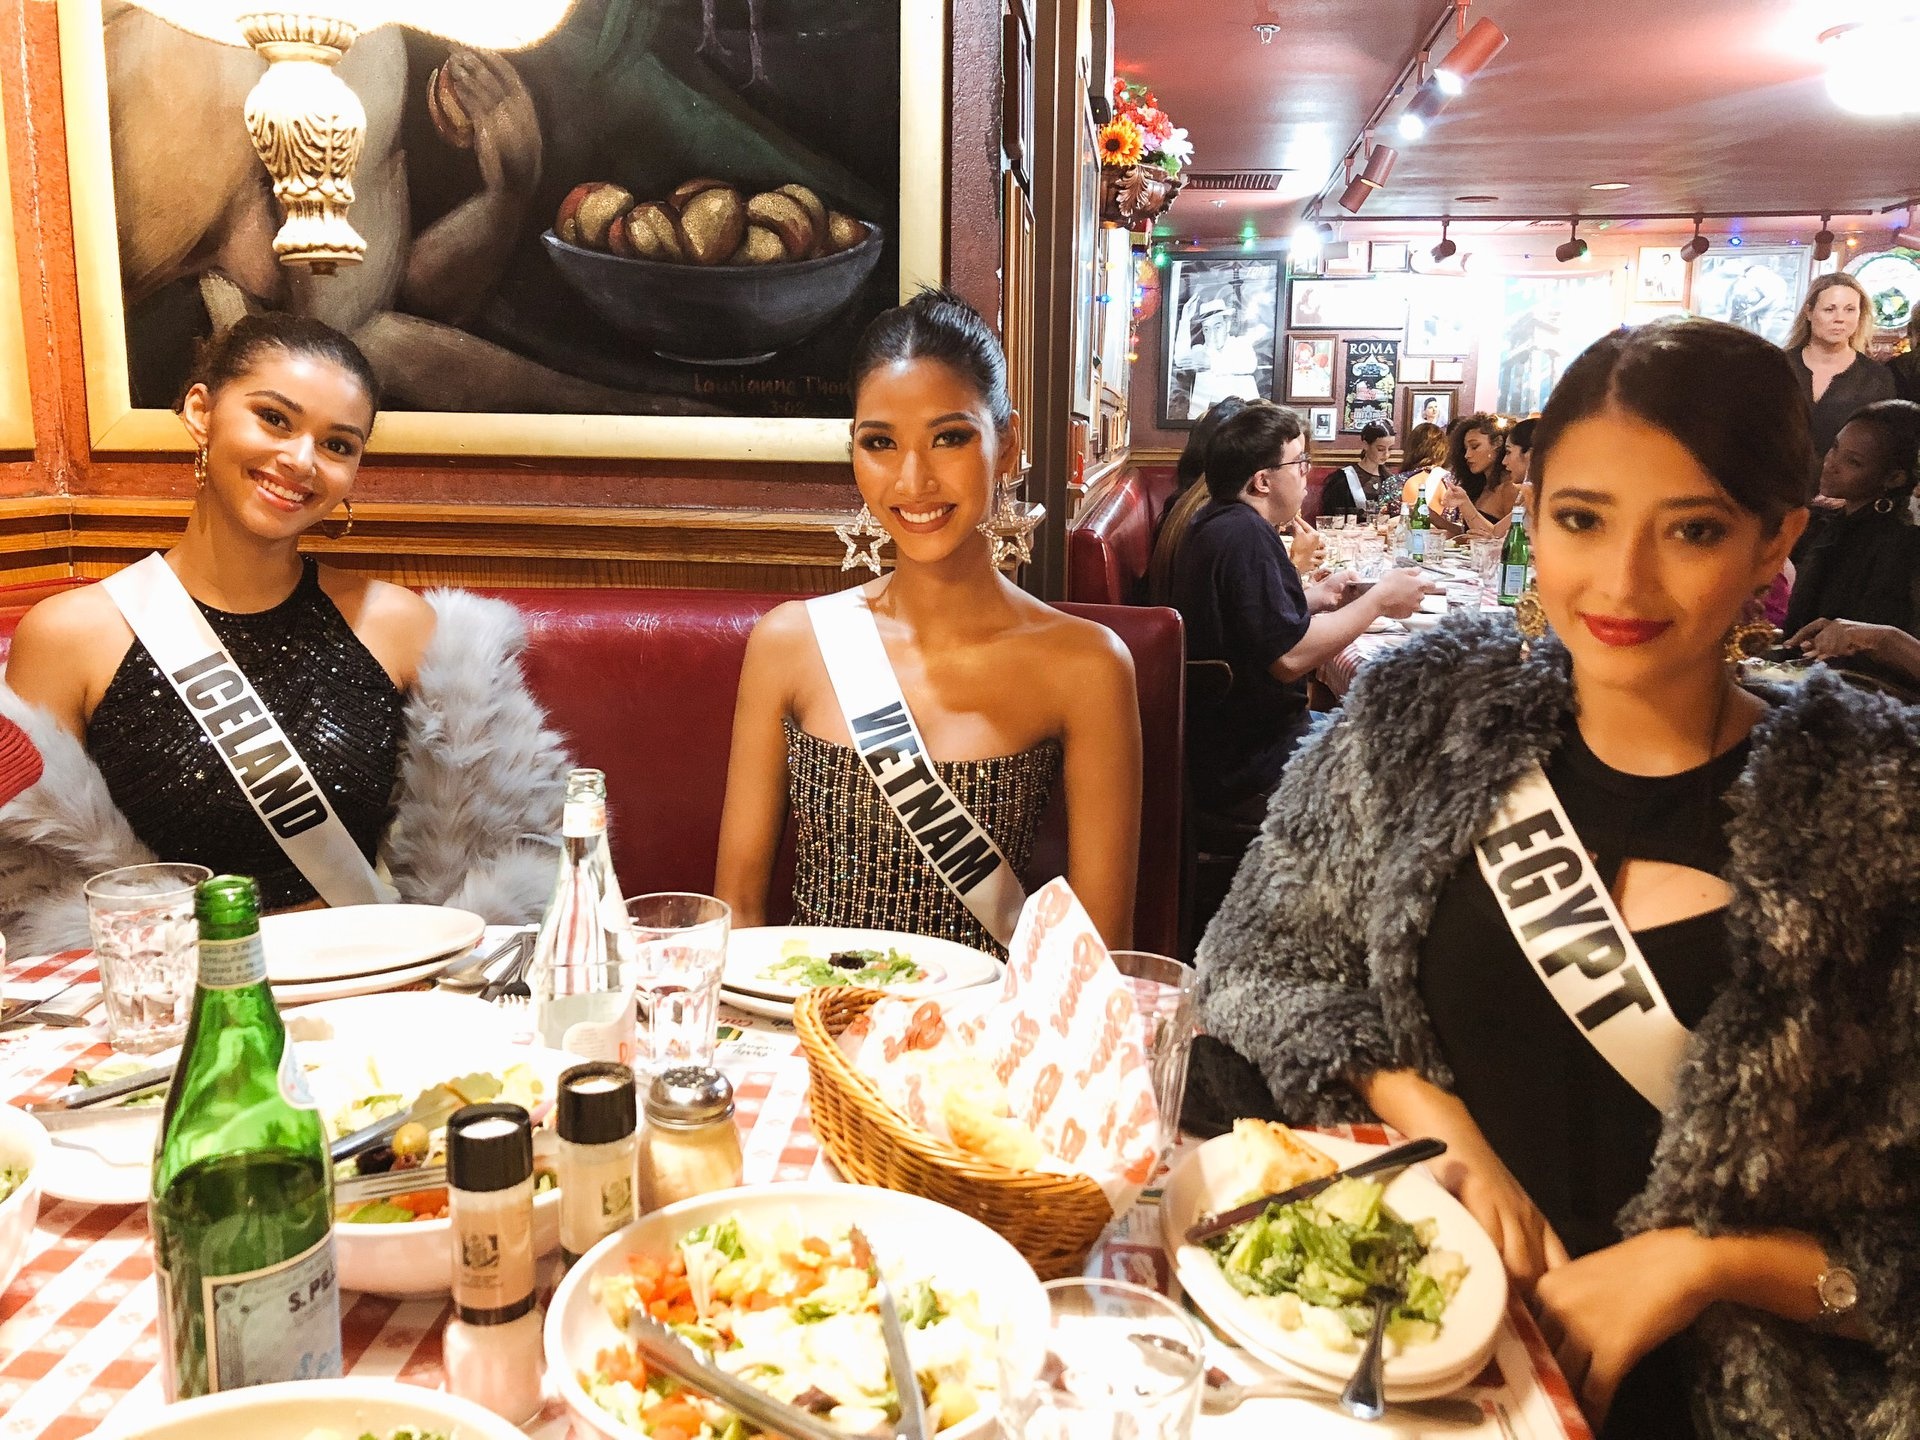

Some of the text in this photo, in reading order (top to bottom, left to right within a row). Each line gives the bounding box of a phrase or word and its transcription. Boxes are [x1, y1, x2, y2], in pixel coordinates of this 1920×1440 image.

[1349, 343, 1395, 355] ROMA
[172, 650, 328, 839] ICELAND
[851, 700, 1002, 896] VIETNAM
[1478, 808, 1656, 1032] EGYPT
